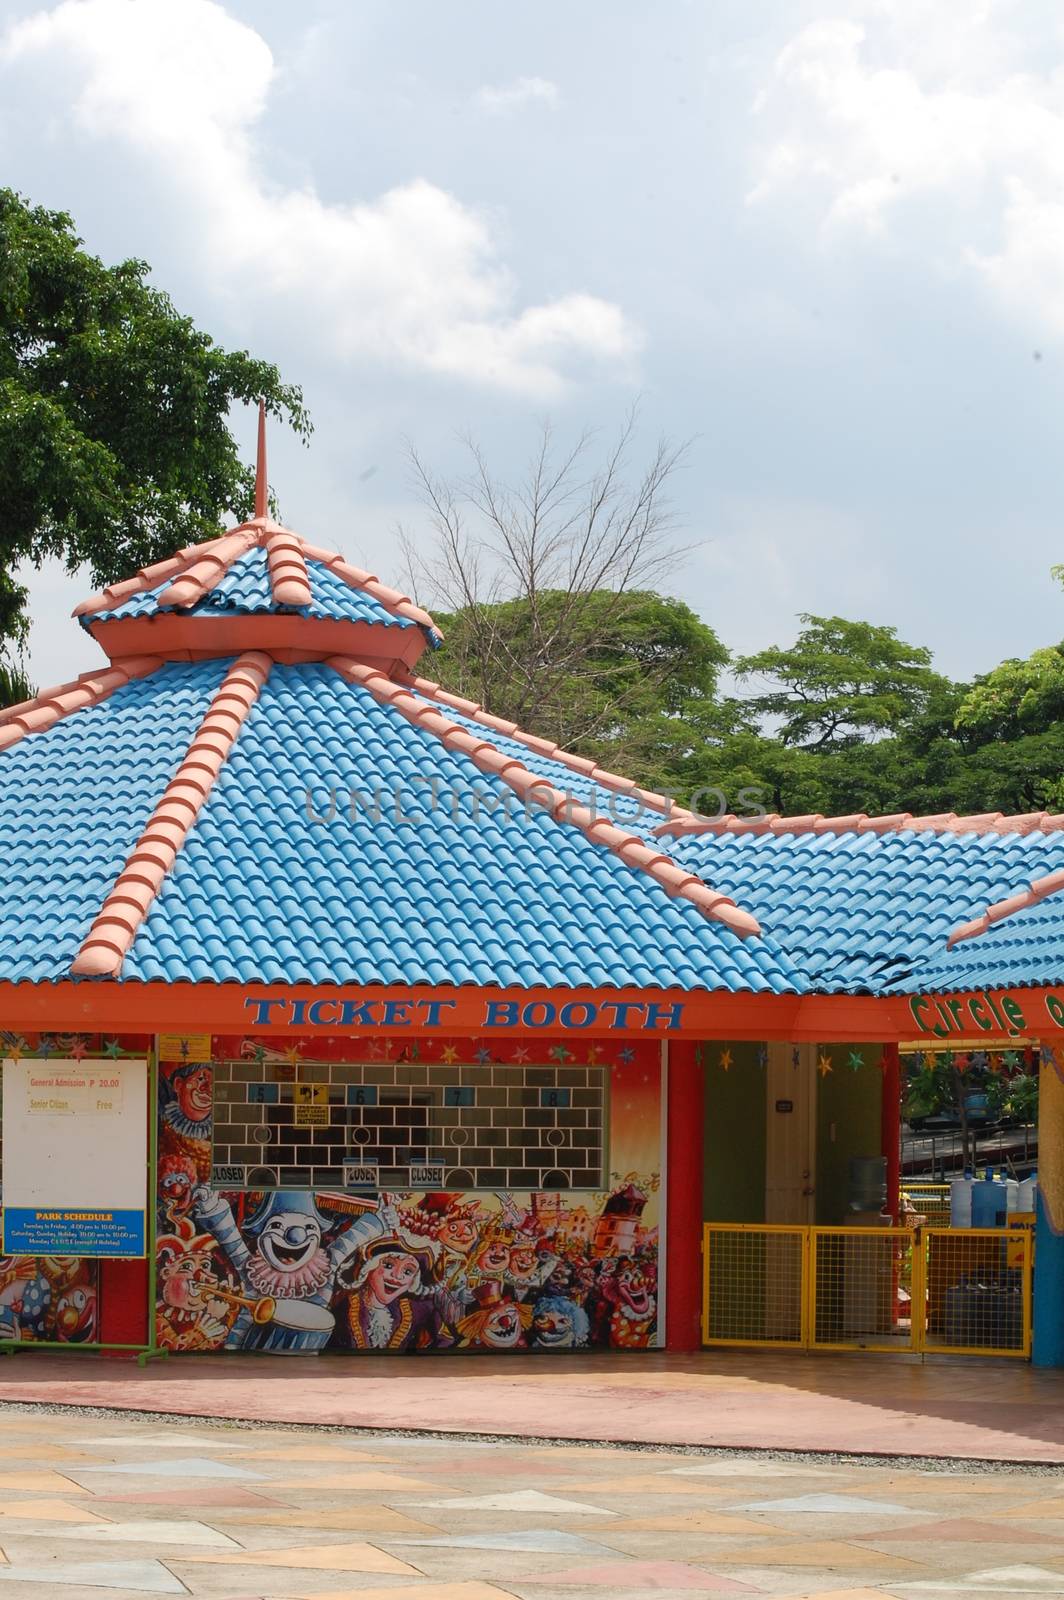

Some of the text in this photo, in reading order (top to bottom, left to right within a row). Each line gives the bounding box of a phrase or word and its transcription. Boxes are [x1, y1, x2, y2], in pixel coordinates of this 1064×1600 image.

[244, 998, 684, 1028] TICKET BOOTH
[909, 992, 1028, 1038] Circle
[30, 1078, 53, 1087] General
[55, 1079, 86, 1087] Admission
[98, 1080, 120, 1088] 20.00
[256, 1086, 265, 1103] 5
[356, 1089, 365, 1105] 6
[453, 1090, 461, 1106] 7
[548, 1091, 558, 1107] 8
[30, 1100, 49, 1109] Senior
[96, 1101, 113, 1110] Free
[36, 1213, 113, 1222] PARK SCHEDULE
